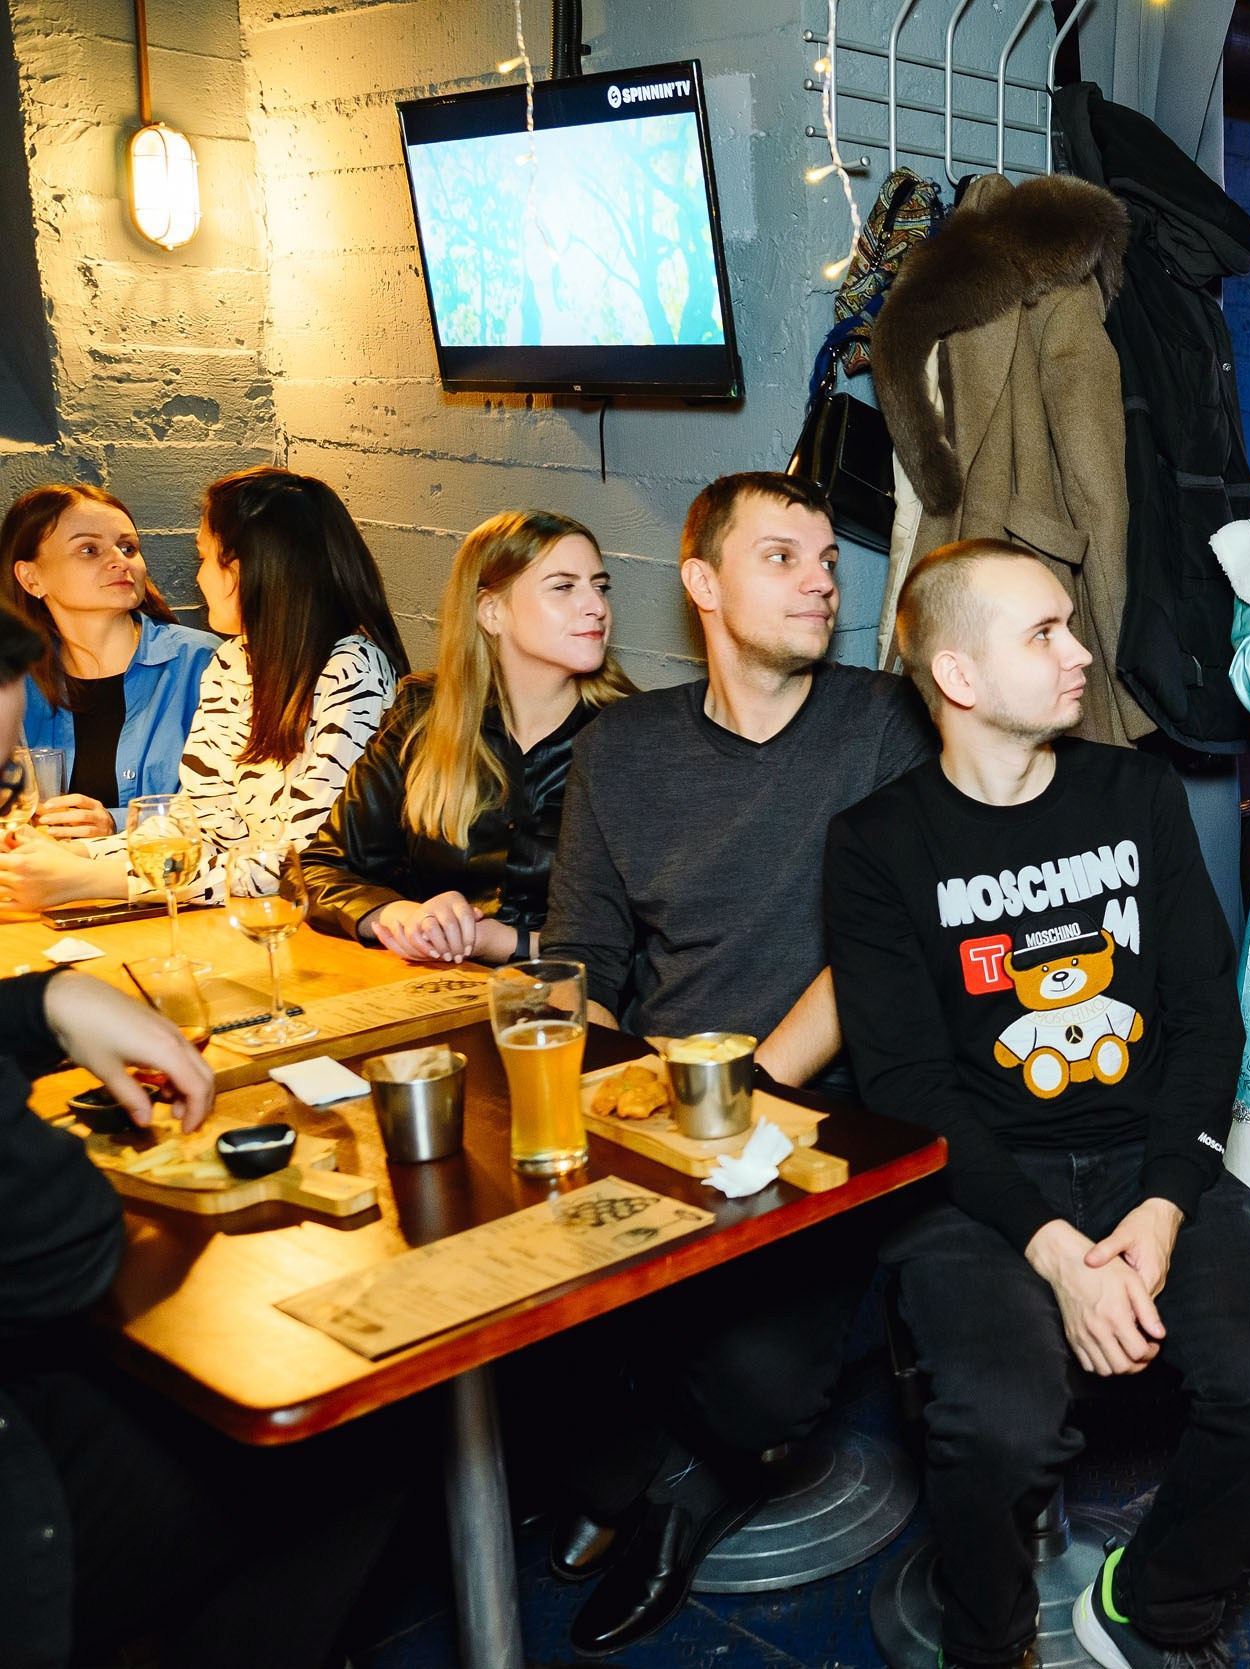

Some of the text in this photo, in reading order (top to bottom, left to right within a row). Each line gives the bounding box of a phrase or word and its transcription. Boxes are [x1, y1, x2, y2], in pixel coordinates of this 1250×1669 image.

[937, 840, 1140, 928] MOSCHINO
[1025, 922, 1081, 948] MOSCHINO
[969, 944, 1005, 983] T
[1033, 998, 1105, 1024] MOSCHINO
